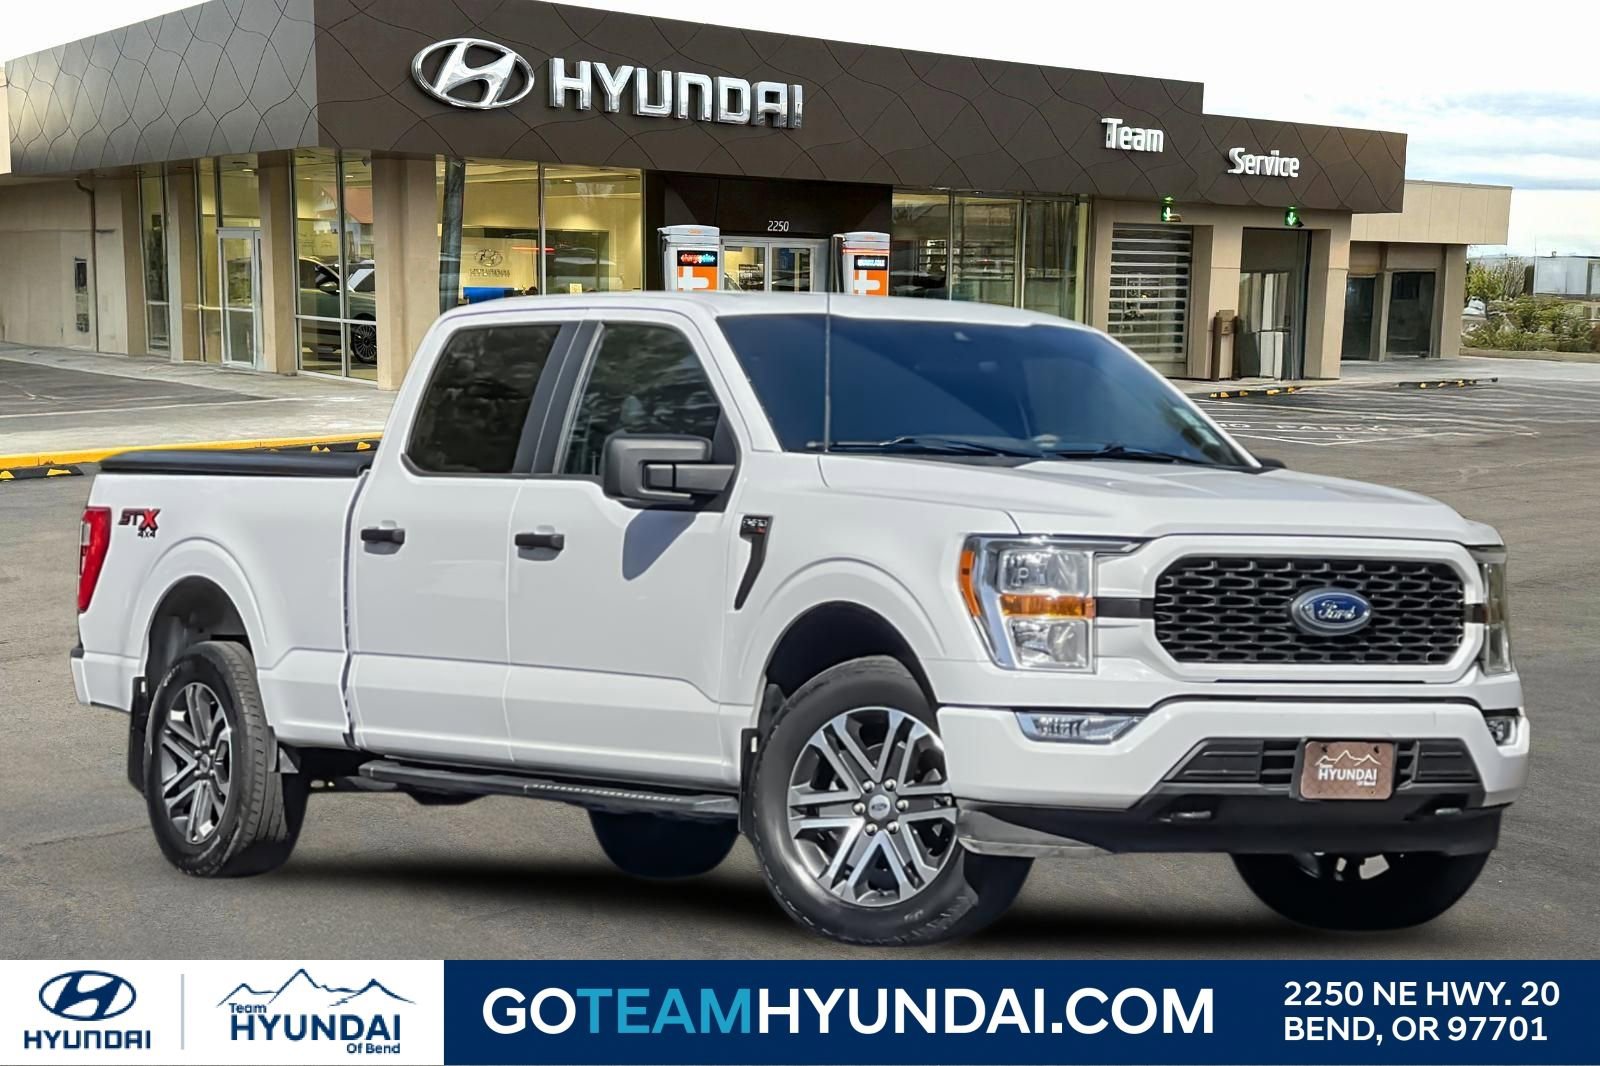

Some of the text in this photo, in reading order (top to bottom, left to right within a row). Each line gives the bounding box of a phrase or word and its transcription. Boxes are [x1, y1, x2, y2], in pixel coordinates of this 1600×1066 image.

[549, 57, 803, 129] HYUNDAI
[1101, 117, 1164, 152] Team
[1227, 147, 1300, 178] Service
[767, 220, 790, 232] 2250
[118, 508, 160, 531] STX
[1318, 600, 1356, 620] Ford
[1318, 768, 1378, 781] HYUNDAI
